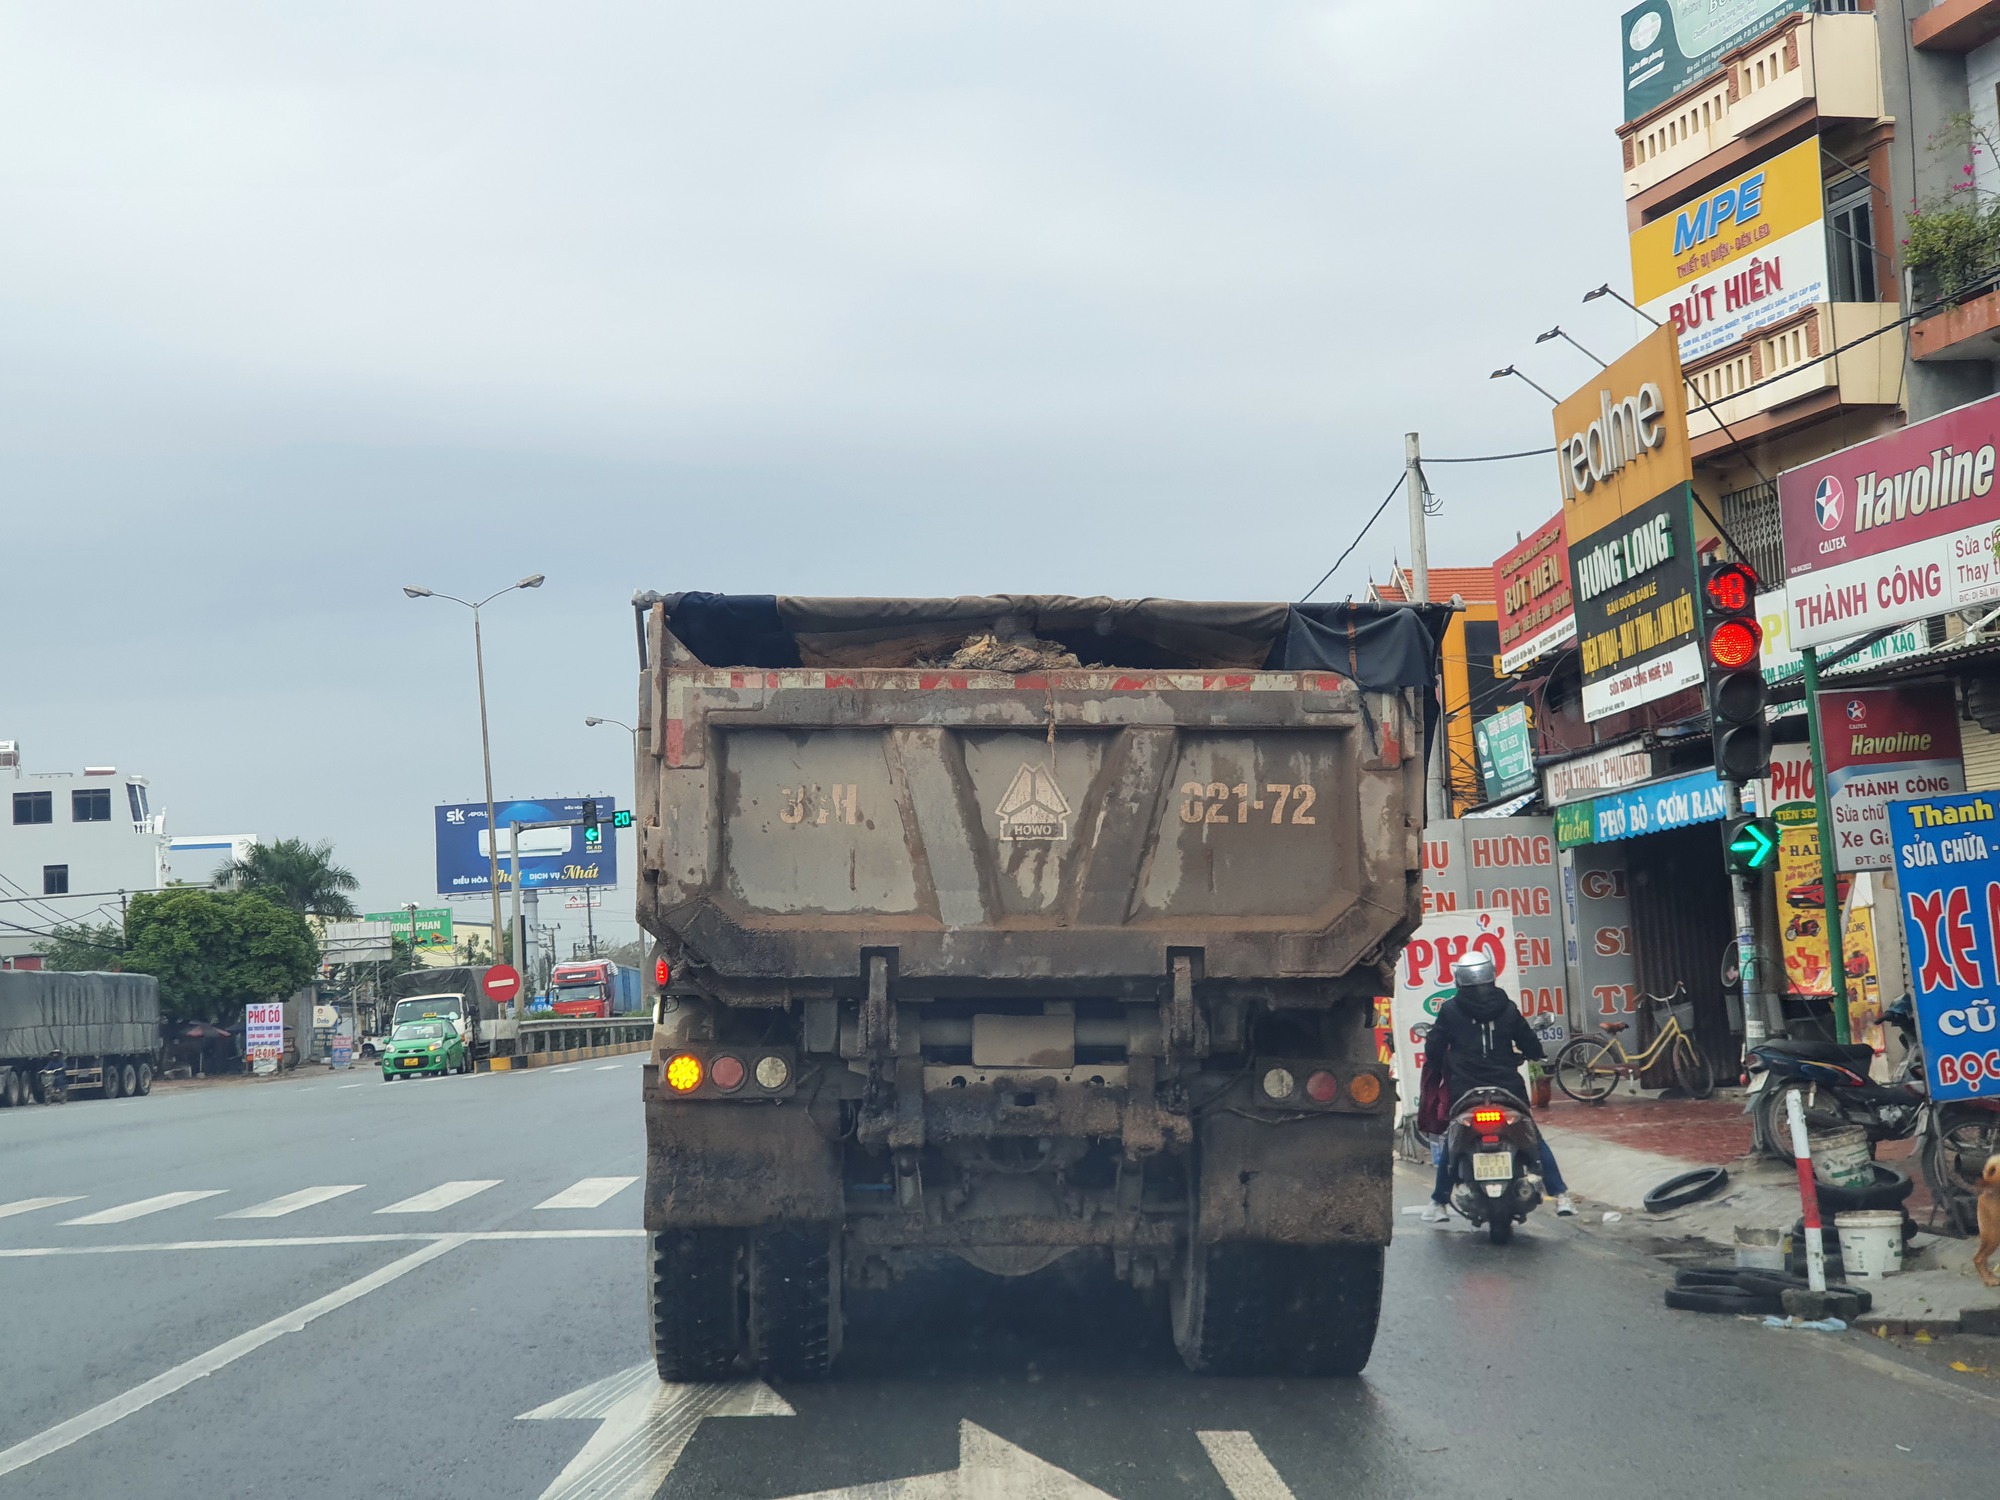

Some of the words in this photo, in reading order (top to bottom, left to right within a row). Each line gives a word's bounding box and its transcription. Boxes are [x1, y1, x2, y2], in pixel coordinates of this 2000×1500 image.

[1672, 171, 1766, 256] MPE
[1754, 223, 1771, 242] LED
[1669, 283, 1717, 336] BÚT
[1724, 256, 1784, 313] HIÊN
[1560, 382, 1666, 501] realme
[1854, 444, 1997, 534] Havoline
[1577, 540, 1624, 602] HƯNG
[1622, 512, 1674, 579] LONG
[1818, 536, 1847, 555] CALTEX
[1955, 535, 1980, 559] Sửa
[1957, 563, 1989, 584] Thay
[1504, 573, 1530, 616] BÚT
[1707, 572, 1746, 609] 48
[1795, 583, 1868, 630] THÀNH
[1877, 563, 1942, 610] CÔNG
[1662, 661, 1674, 676] CAO
[1850, 731, 1932, 756] Havoline
[1844, 778, 1900, 798] THÀNH
[1905, 775, 1950, 795] CÔNG
[614, 811, 630, 826] 20
[1599, 797, 1626, 838] PHỞ
[1630, 796, 1648, 832] BÒ
[1657, 790, 1690, 826] CƠM
[1836, 804, 1859, 824] Sửa
[1862, 803, 1885, 822] chữ
[1907, 798, 1994, 829] Thành
[1013, 824, 1053, 836] HOWO
[1840, 830, 1864, 849] Xe
[1472, 834, 1552, 868] HƯNG
[1854, 855, 1876, 866] ĐT:
[1902, 833, 1939, 869] SỬA
[1940, 831, 1990, 865] CHỮA
[470, 873, 489, 884] HÒA
[529, 872, 549, 883] DỊCH
[550, 871, 560, 881] VỤ
[560, 862, 599, 880] Nhất
[415, 920, 441, 931] PHAN
[1907, 885, 1984, 996] XE
[1403, 913, 1507, 990] PHỞ
[1514, 932, 1552, 974] ỆN
[1537, 1026, 1564, 1041] 639
[1938, 998, 1997, 1037] CŨ
[1937, 1049, 2000, 1093] BỌC
